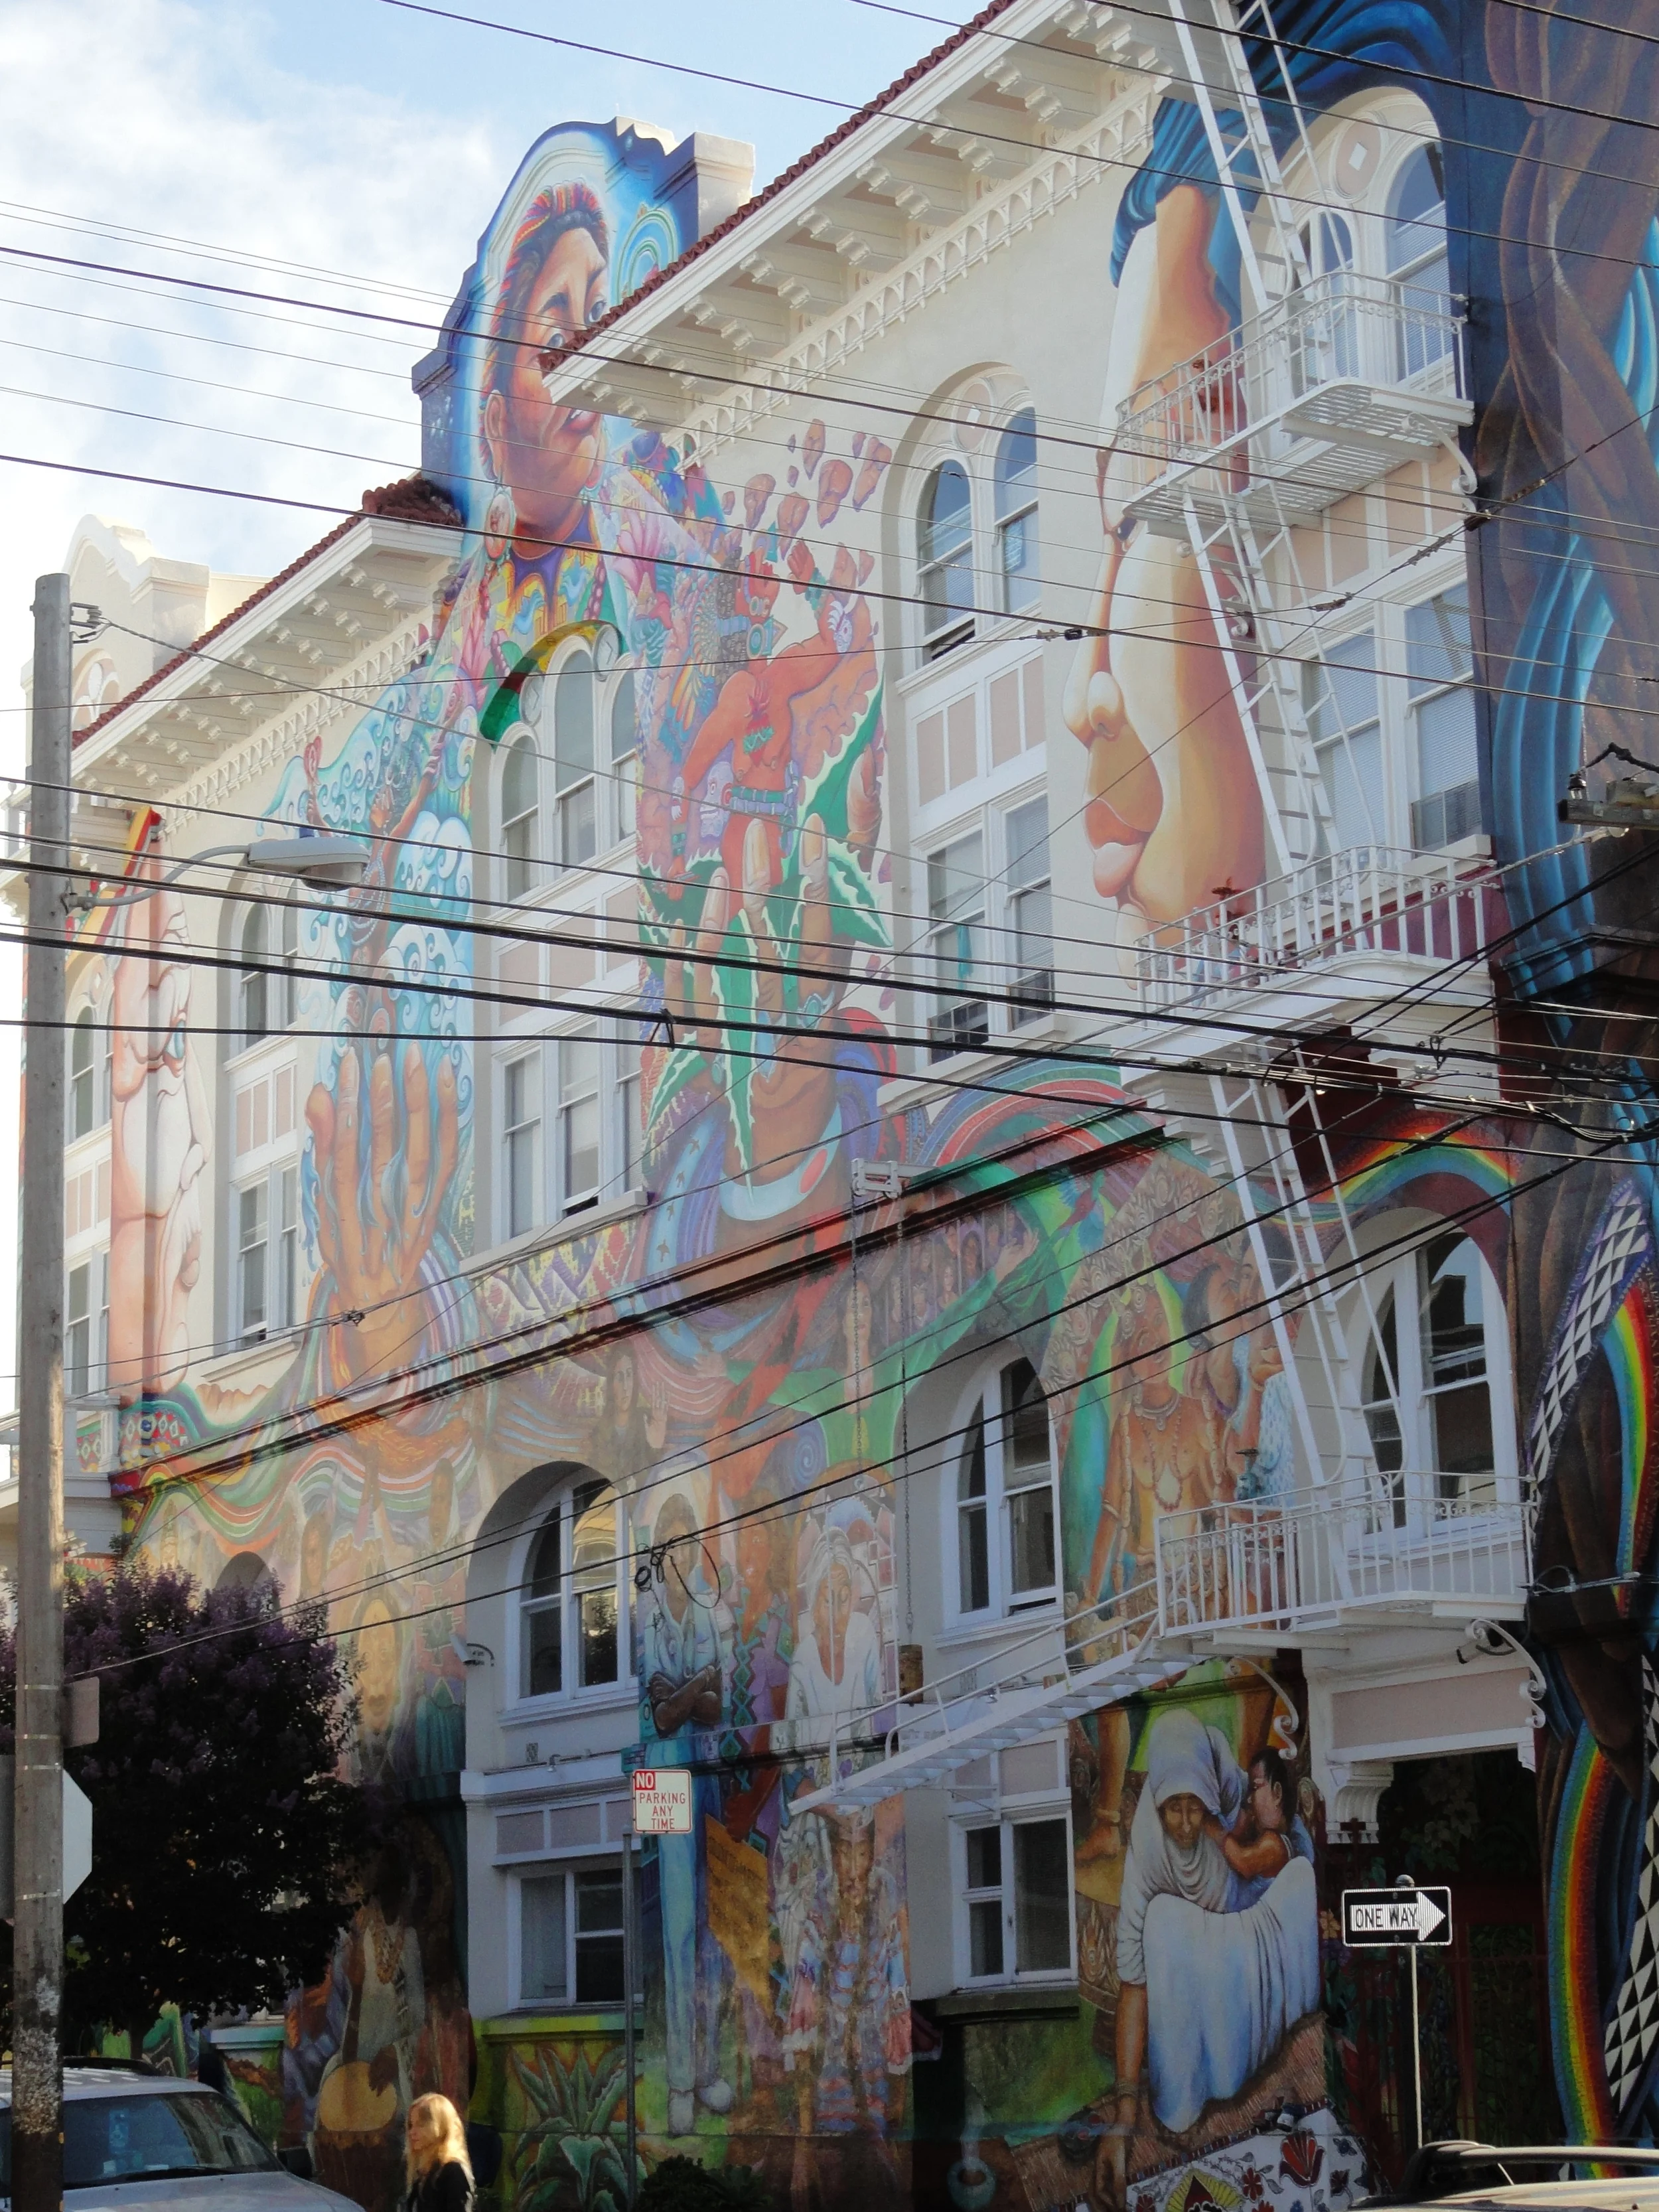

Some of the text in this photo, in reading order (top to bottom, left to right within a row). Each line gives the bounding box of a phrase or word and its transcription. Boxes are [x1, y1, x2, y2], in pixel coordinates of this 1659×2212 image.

[636, 1773, 654, 1789] NO
[639, 1793, 685, 1804] PARKING
[652, 1805, 674, 1816] ANY
[651, 1818, 675, 1830] TIME
[1356, 1907, 1417, 1928] ONE WAY
